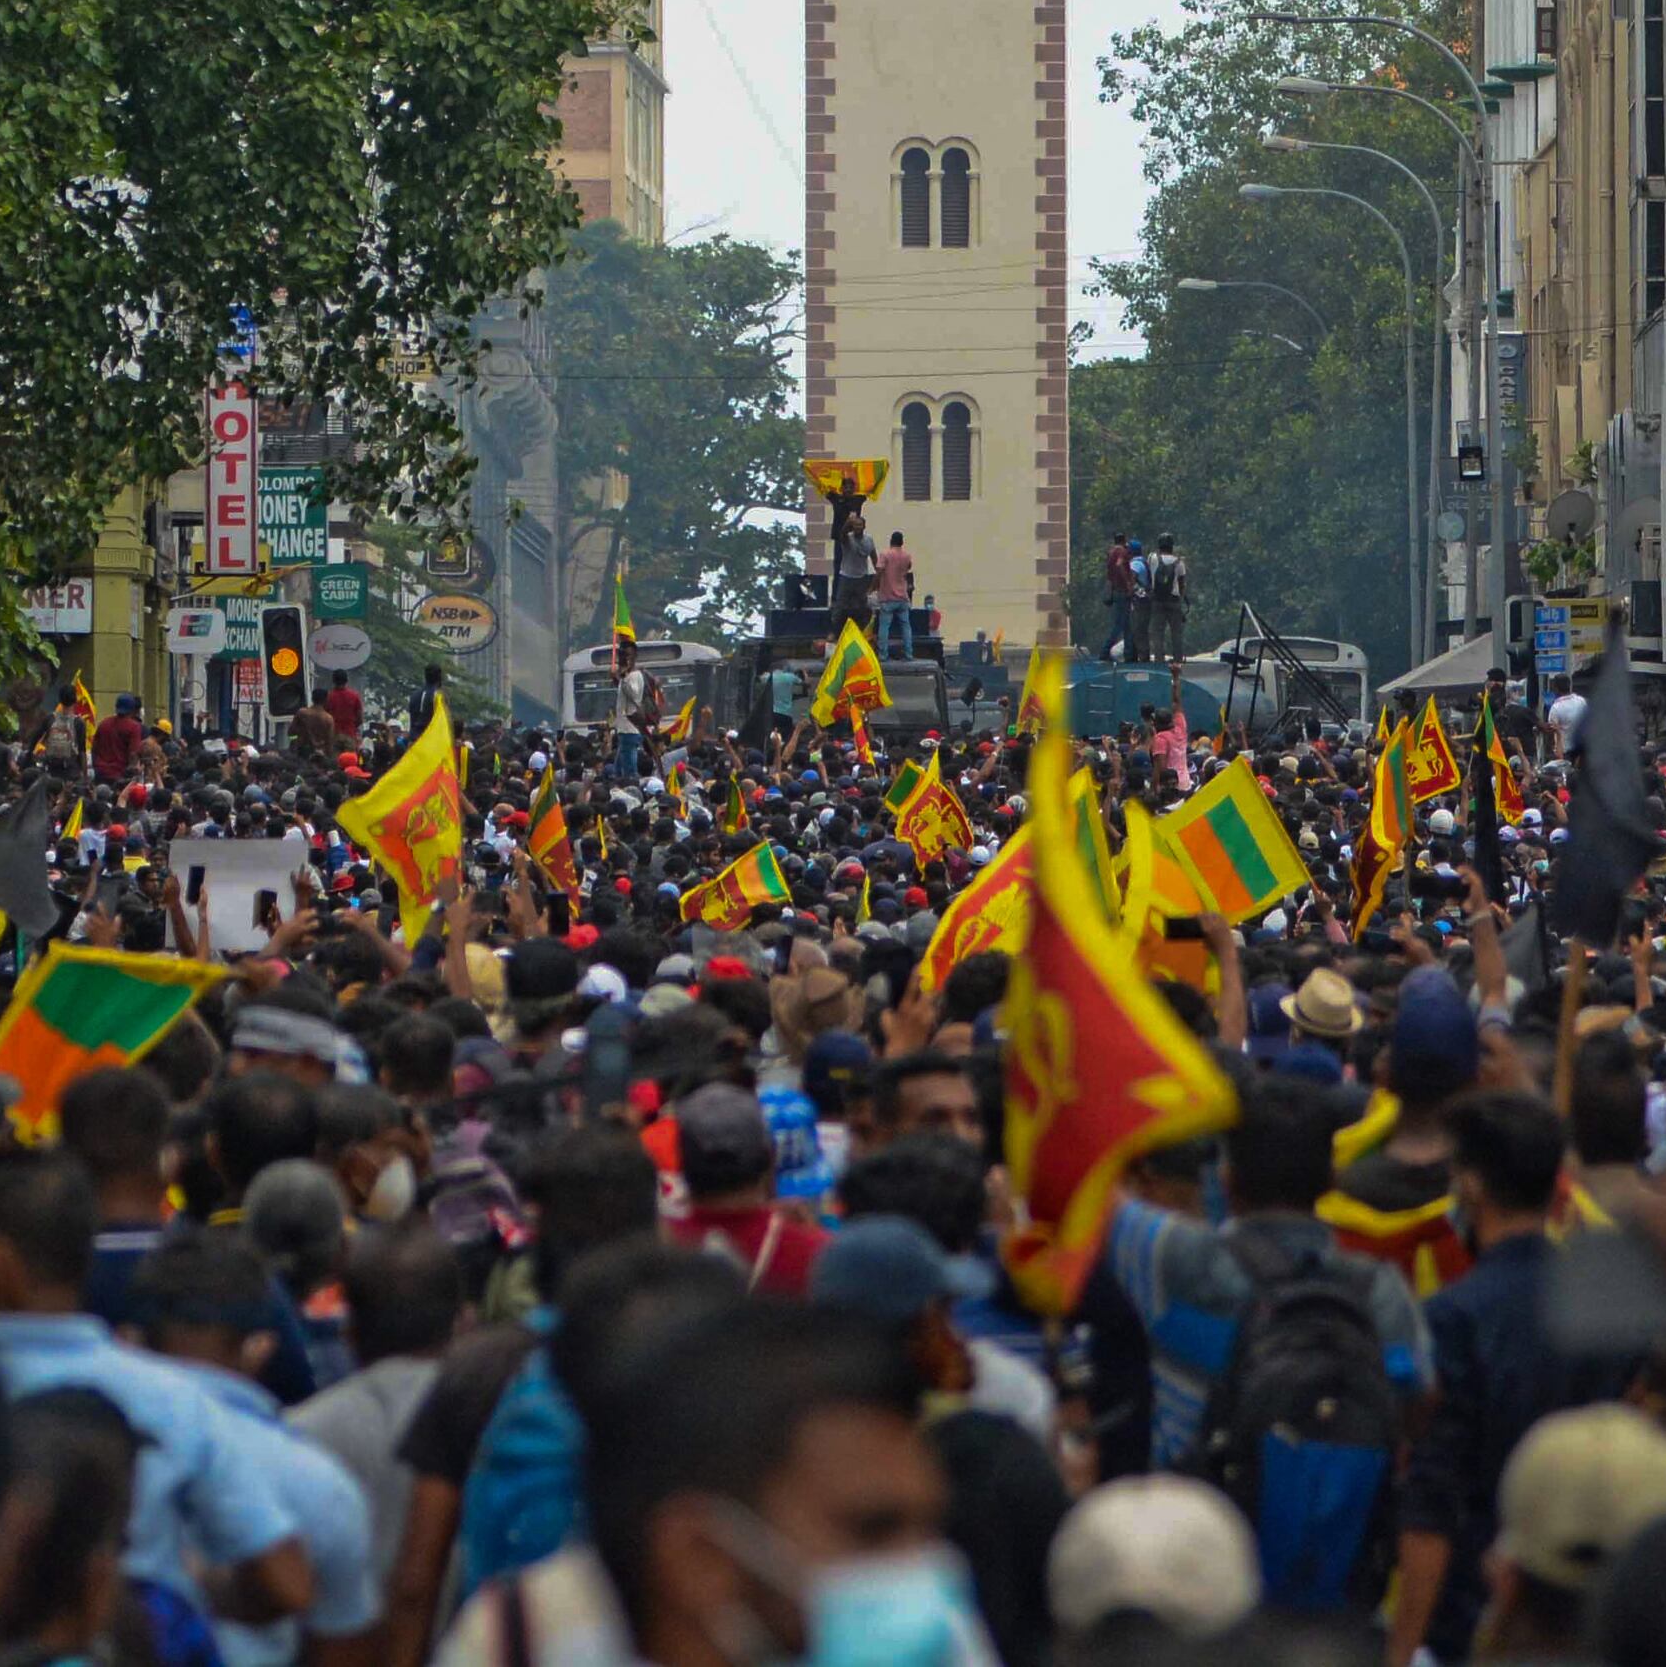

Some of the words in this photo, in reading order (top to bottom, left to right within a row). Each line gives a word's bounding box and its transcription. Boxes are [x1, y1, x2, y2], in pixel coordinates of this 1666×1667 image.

[319, 579, 361, 590] GREEN
[321, 590, 359, 601] CABIN
[430, 607, 459, 620] NSB
[438, 625, 471, 638] ATM
